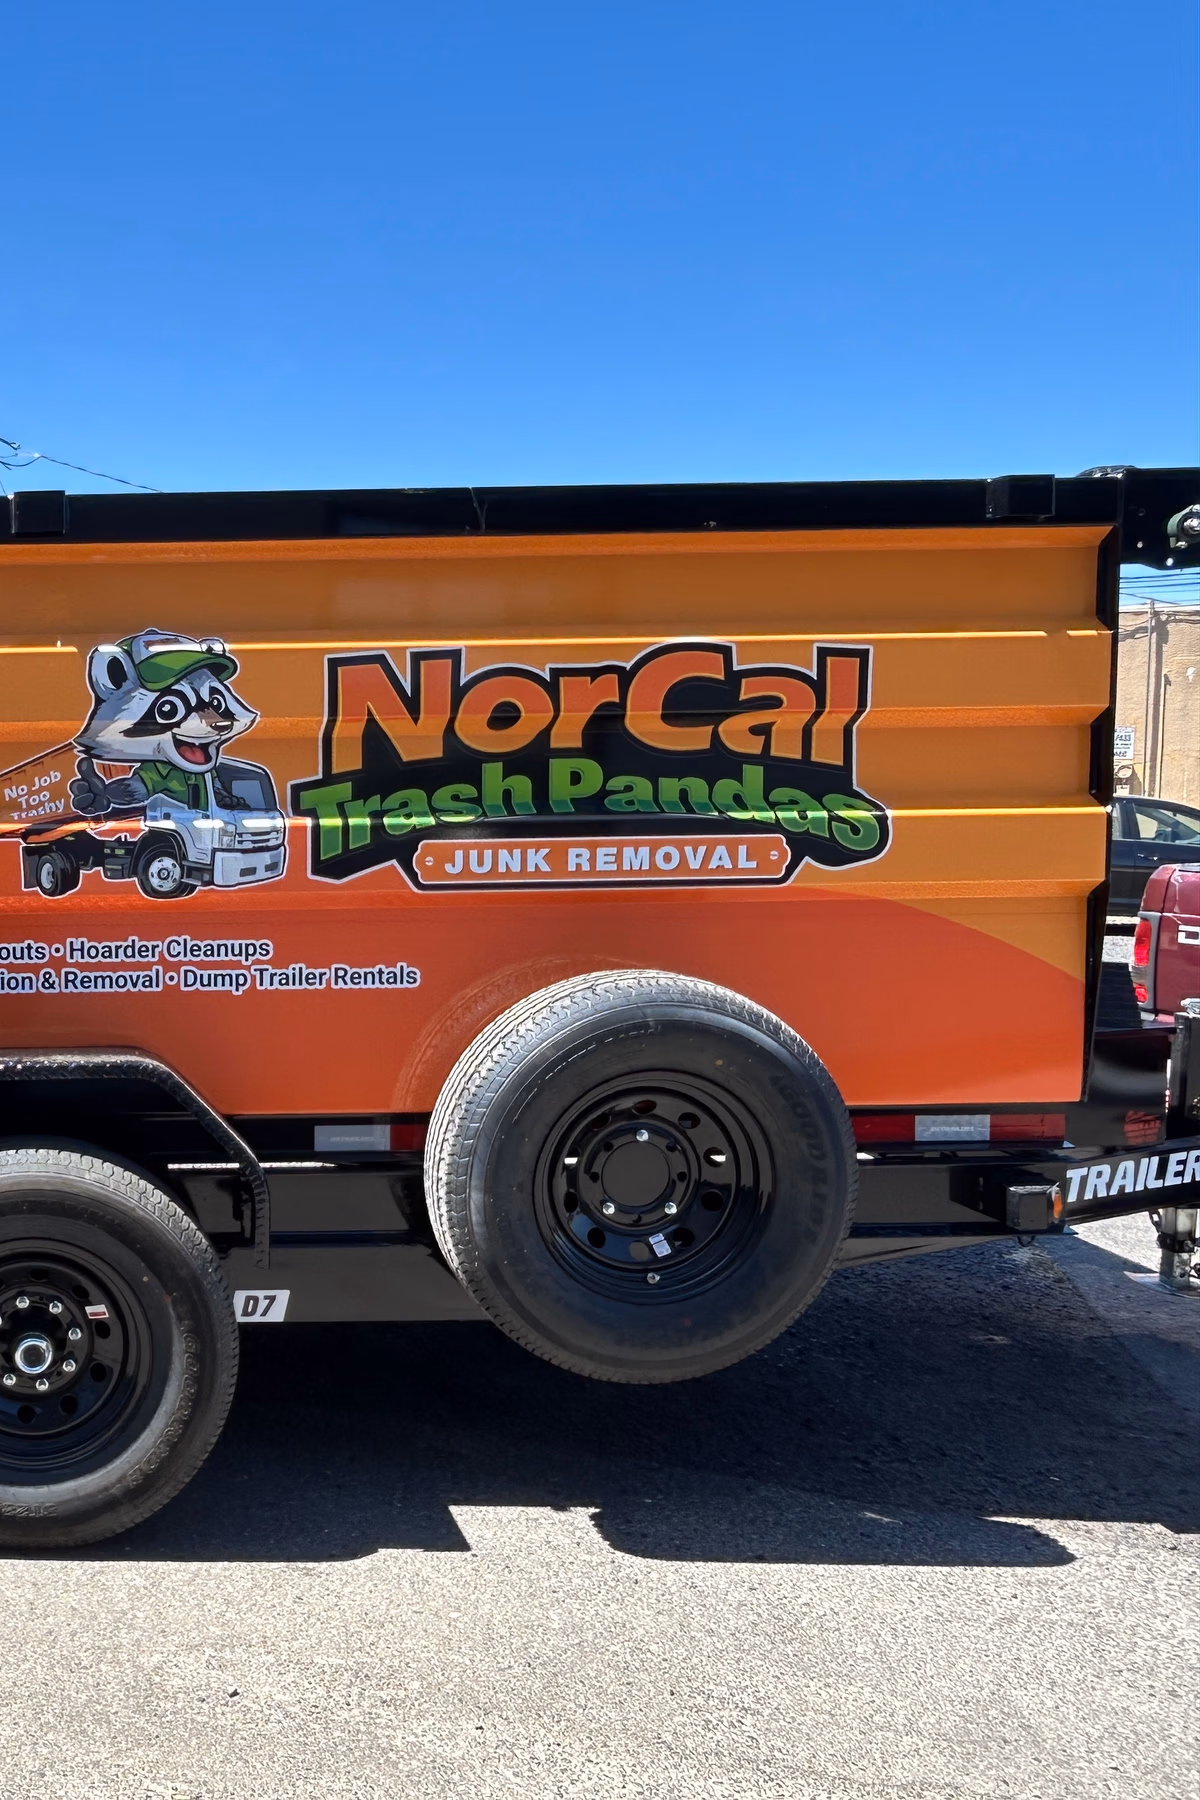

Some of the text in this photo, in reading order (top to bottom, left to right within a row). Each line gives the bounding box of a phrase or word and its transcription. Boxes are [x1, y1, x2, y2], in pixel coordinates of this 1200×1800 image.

[326, 645, 866, 776] NorCal
[4, 770, 61, 801] No Job
[17, 795, 50, 808] Too
[300, 757, 882, 861] Trash Pandas
[444, 845, 758, 875] JUNK REMOVAL
[67, 937, 161, 962] Hoarder
[164, 936, 273, 965] Cleanups
[39, 968, 59, 991] &
[63, 966, 163, 992] Removal
[181, 967, 249, 994] Dump
[252, 964, 328, 989] Trailer
[330, 962, 421, 989] Rentals
[241, 1295, 276, 1317] D7
